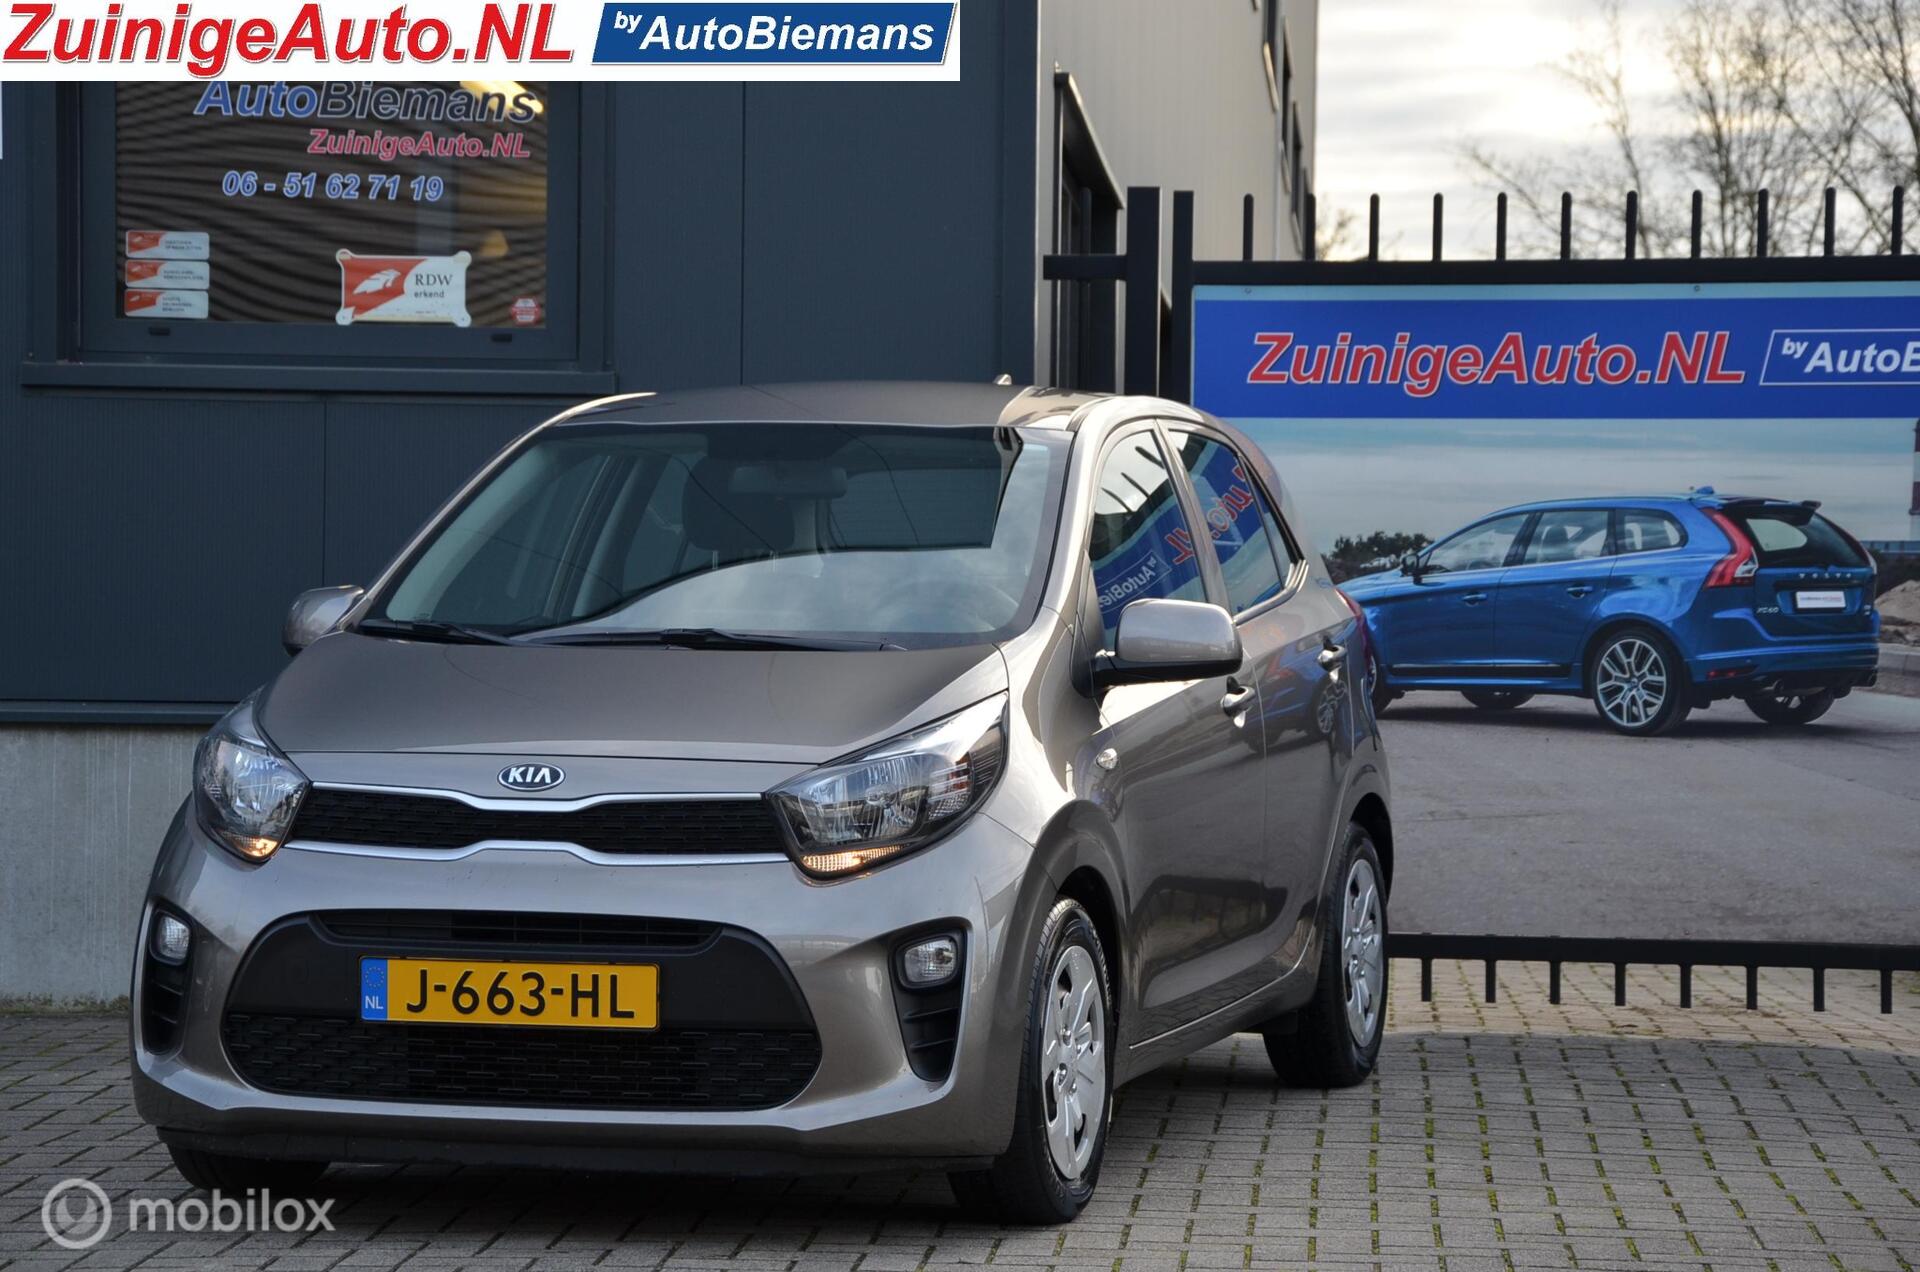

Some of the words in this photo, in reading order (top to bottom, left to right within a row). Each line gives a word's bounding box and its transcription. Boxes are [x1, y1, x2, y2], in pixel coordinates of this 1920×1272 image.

[194, 81, 539, 123] AutoBiemans
[307, 129, 531, 161] ZuinigeAuto.NL
[222, 170, 258, 197] 06
[283, 172, 317, 198] 51
[325, 174, 361, 200] 62
[368, 175, 401, 201] 71
[410, 176, 445, 201] 19
[415, 273, 453, 287] RDW
[414, 289, 445, 298] erkend
[1781, 337, 1809, 359] by
[1247, 331, 1746, 397] ZuinigeAuto.NL
[507, 766, 552, 784] KIA
[364, 995, 384, 1010] NL
[406, 968, 635, 1019] J-663-HL
